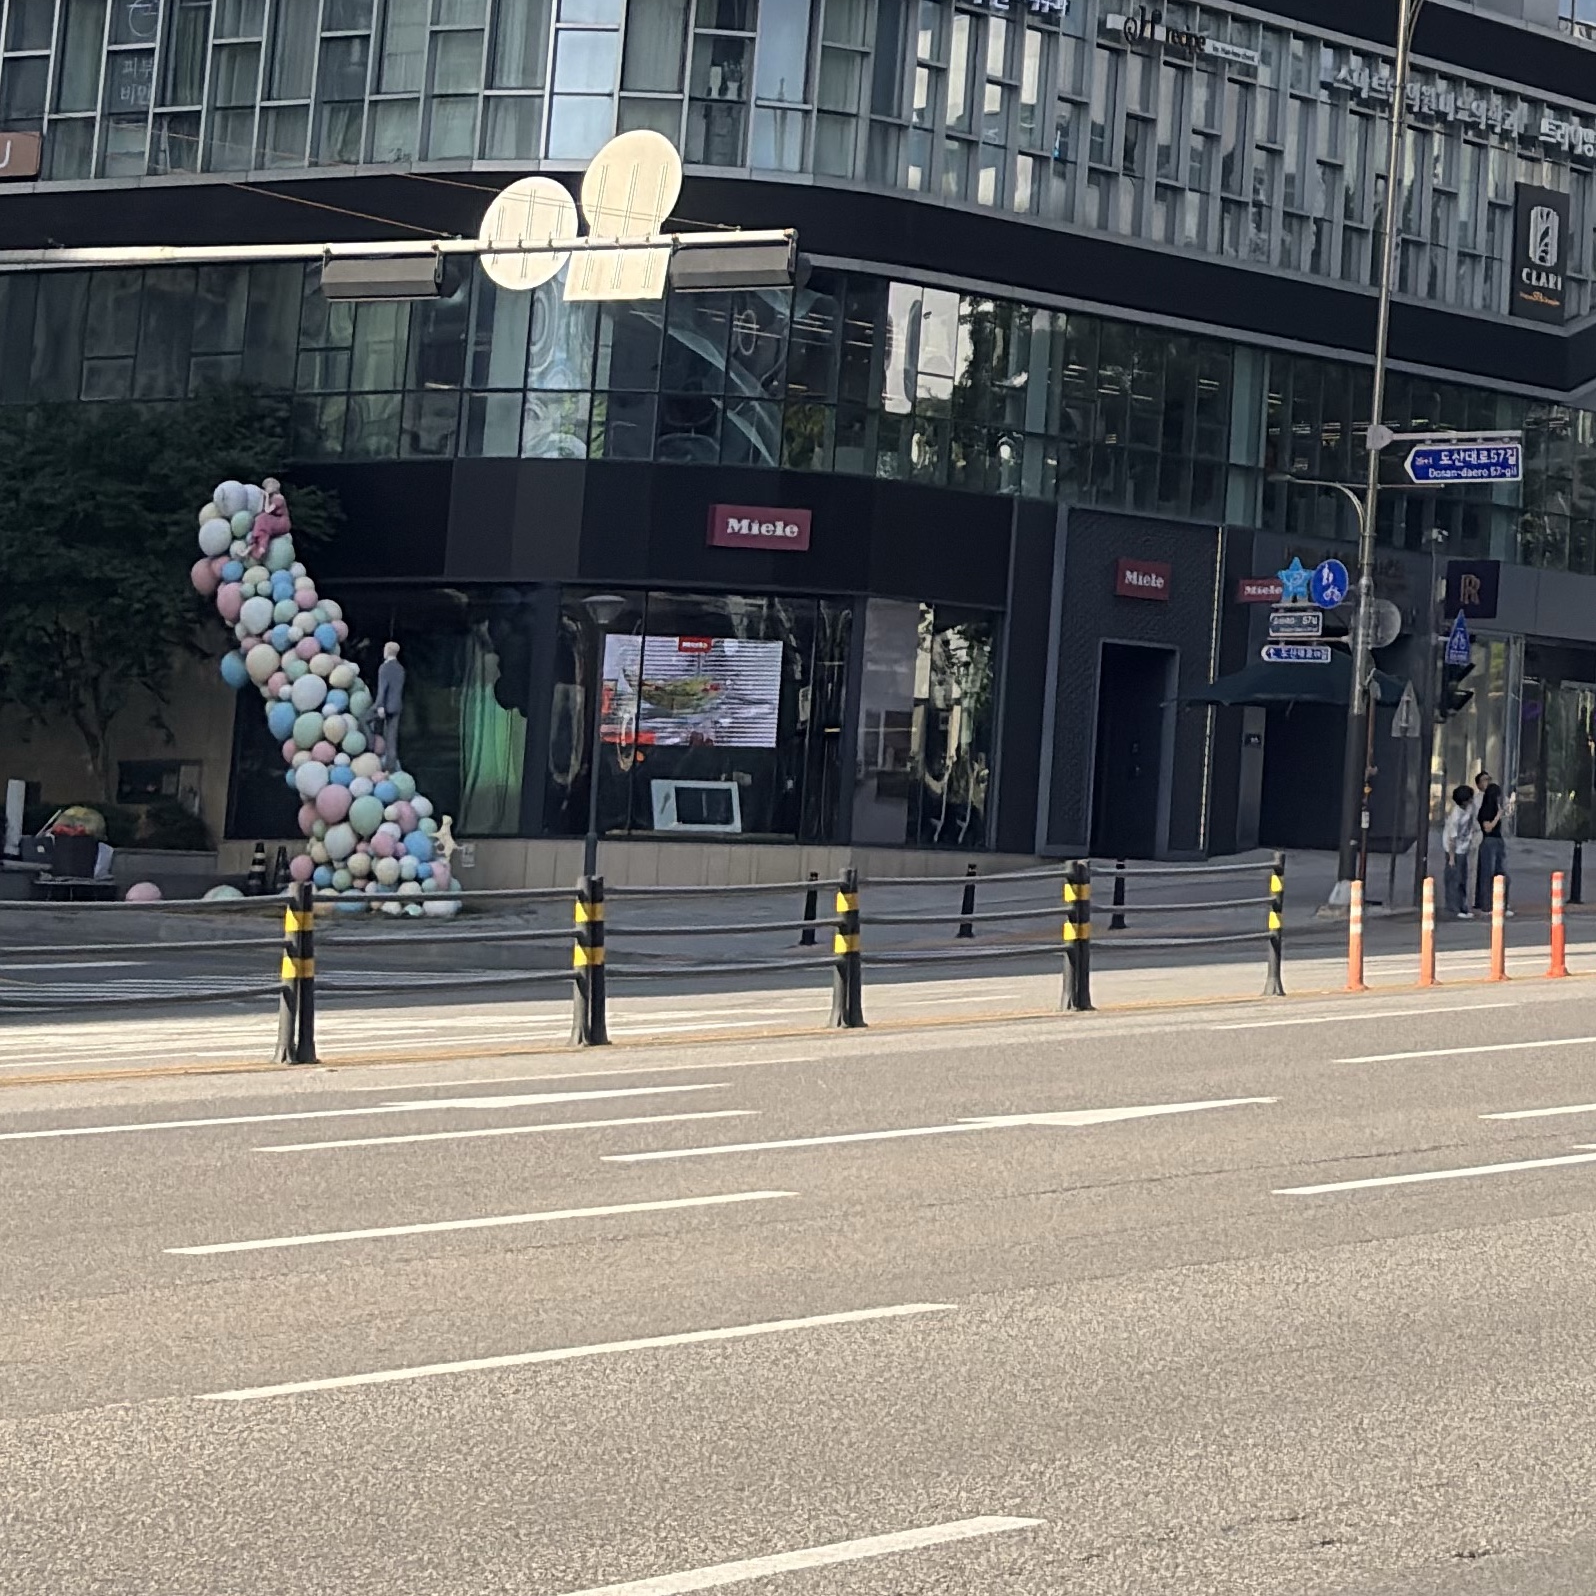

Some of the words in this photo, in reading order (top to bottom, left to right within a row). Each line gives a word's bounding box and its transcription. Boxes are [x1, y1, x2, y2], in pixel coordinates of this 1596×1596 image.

[1438, 449, 1518, 466] 도산대로57길
[726, 516, 799, 539] Miele
[1124, 569, 1165, 589] Miele
